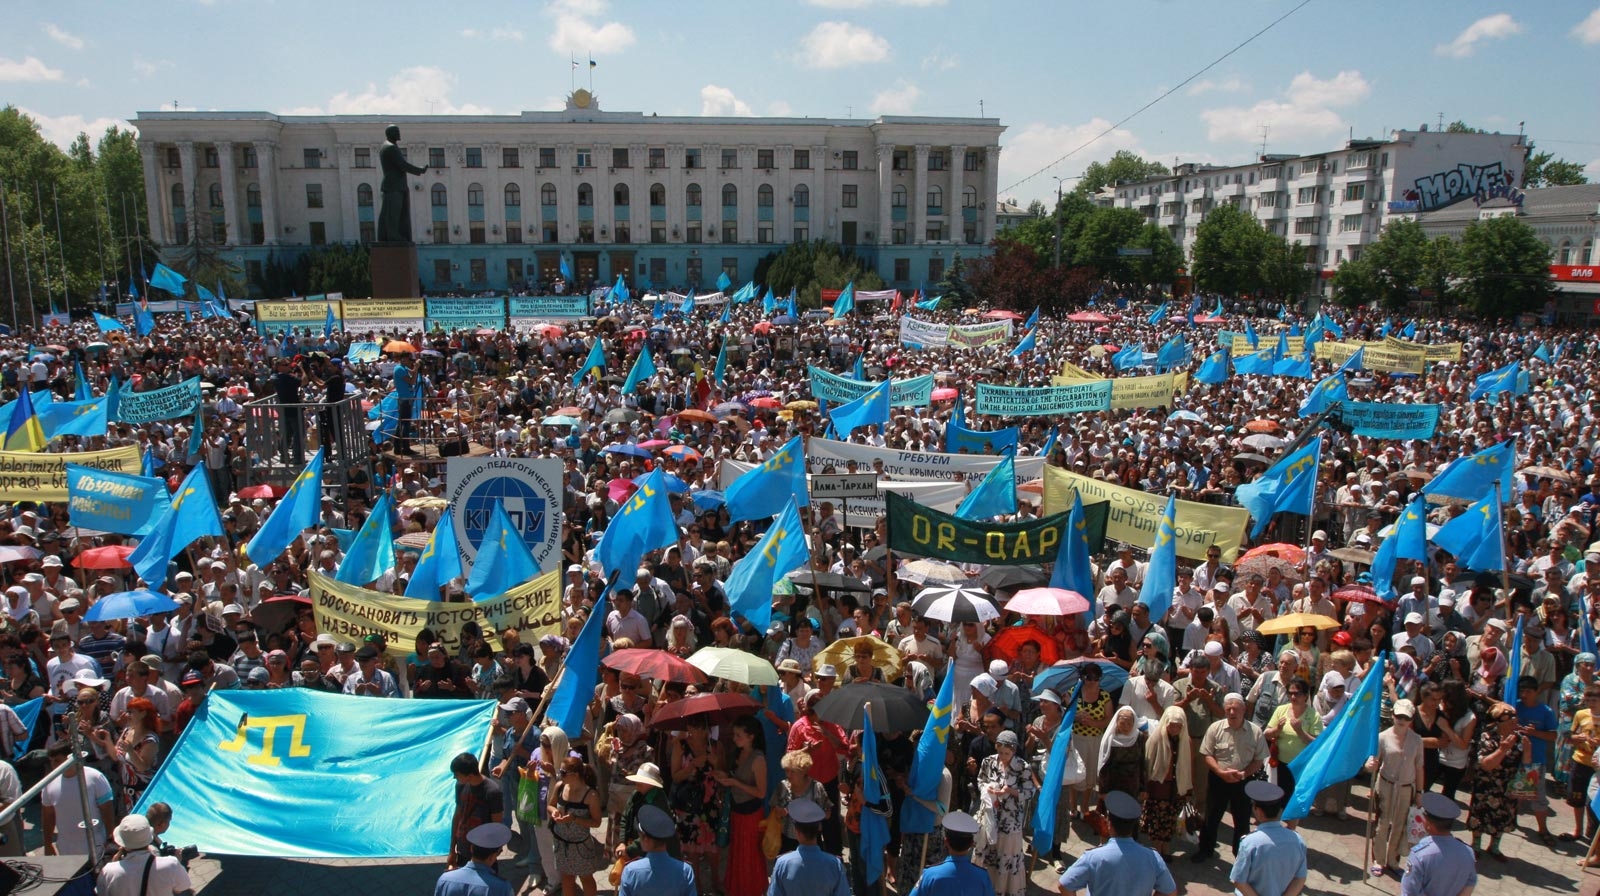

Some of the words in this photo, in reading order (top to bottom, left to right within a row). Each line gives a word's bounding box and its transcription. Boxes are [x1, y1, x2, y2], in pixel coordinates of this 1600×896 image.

[1056, 385, 1092, 394] IMMEDIATE
[984, 396, 1029, 404] RATIFICATION
[1031, 396, 1038, 404] OF
[1040, 395, 1052, 404] THE
[1054, 392, 1098, 402] DECLARATION
[1002, 404, 1026, 412] RIGHTS
[1035, 401, 1074, 410] INDIGENOUS
[898, 452, 950, 465] ТРЕБУЕМ
[910, 468, 988, 482] КРЫМСКОТТАРС
[466, 509, 544, 532] КПУ
[536, 511, 560, 564] УНИВЕРСИ
[1174, 526, 1217, 544] oyar!
[319, 590, 418, 626] ВОССТАНОВИТЬ
[426, 588, 553, 626] ИСТОРИЧЕСКИЕ
